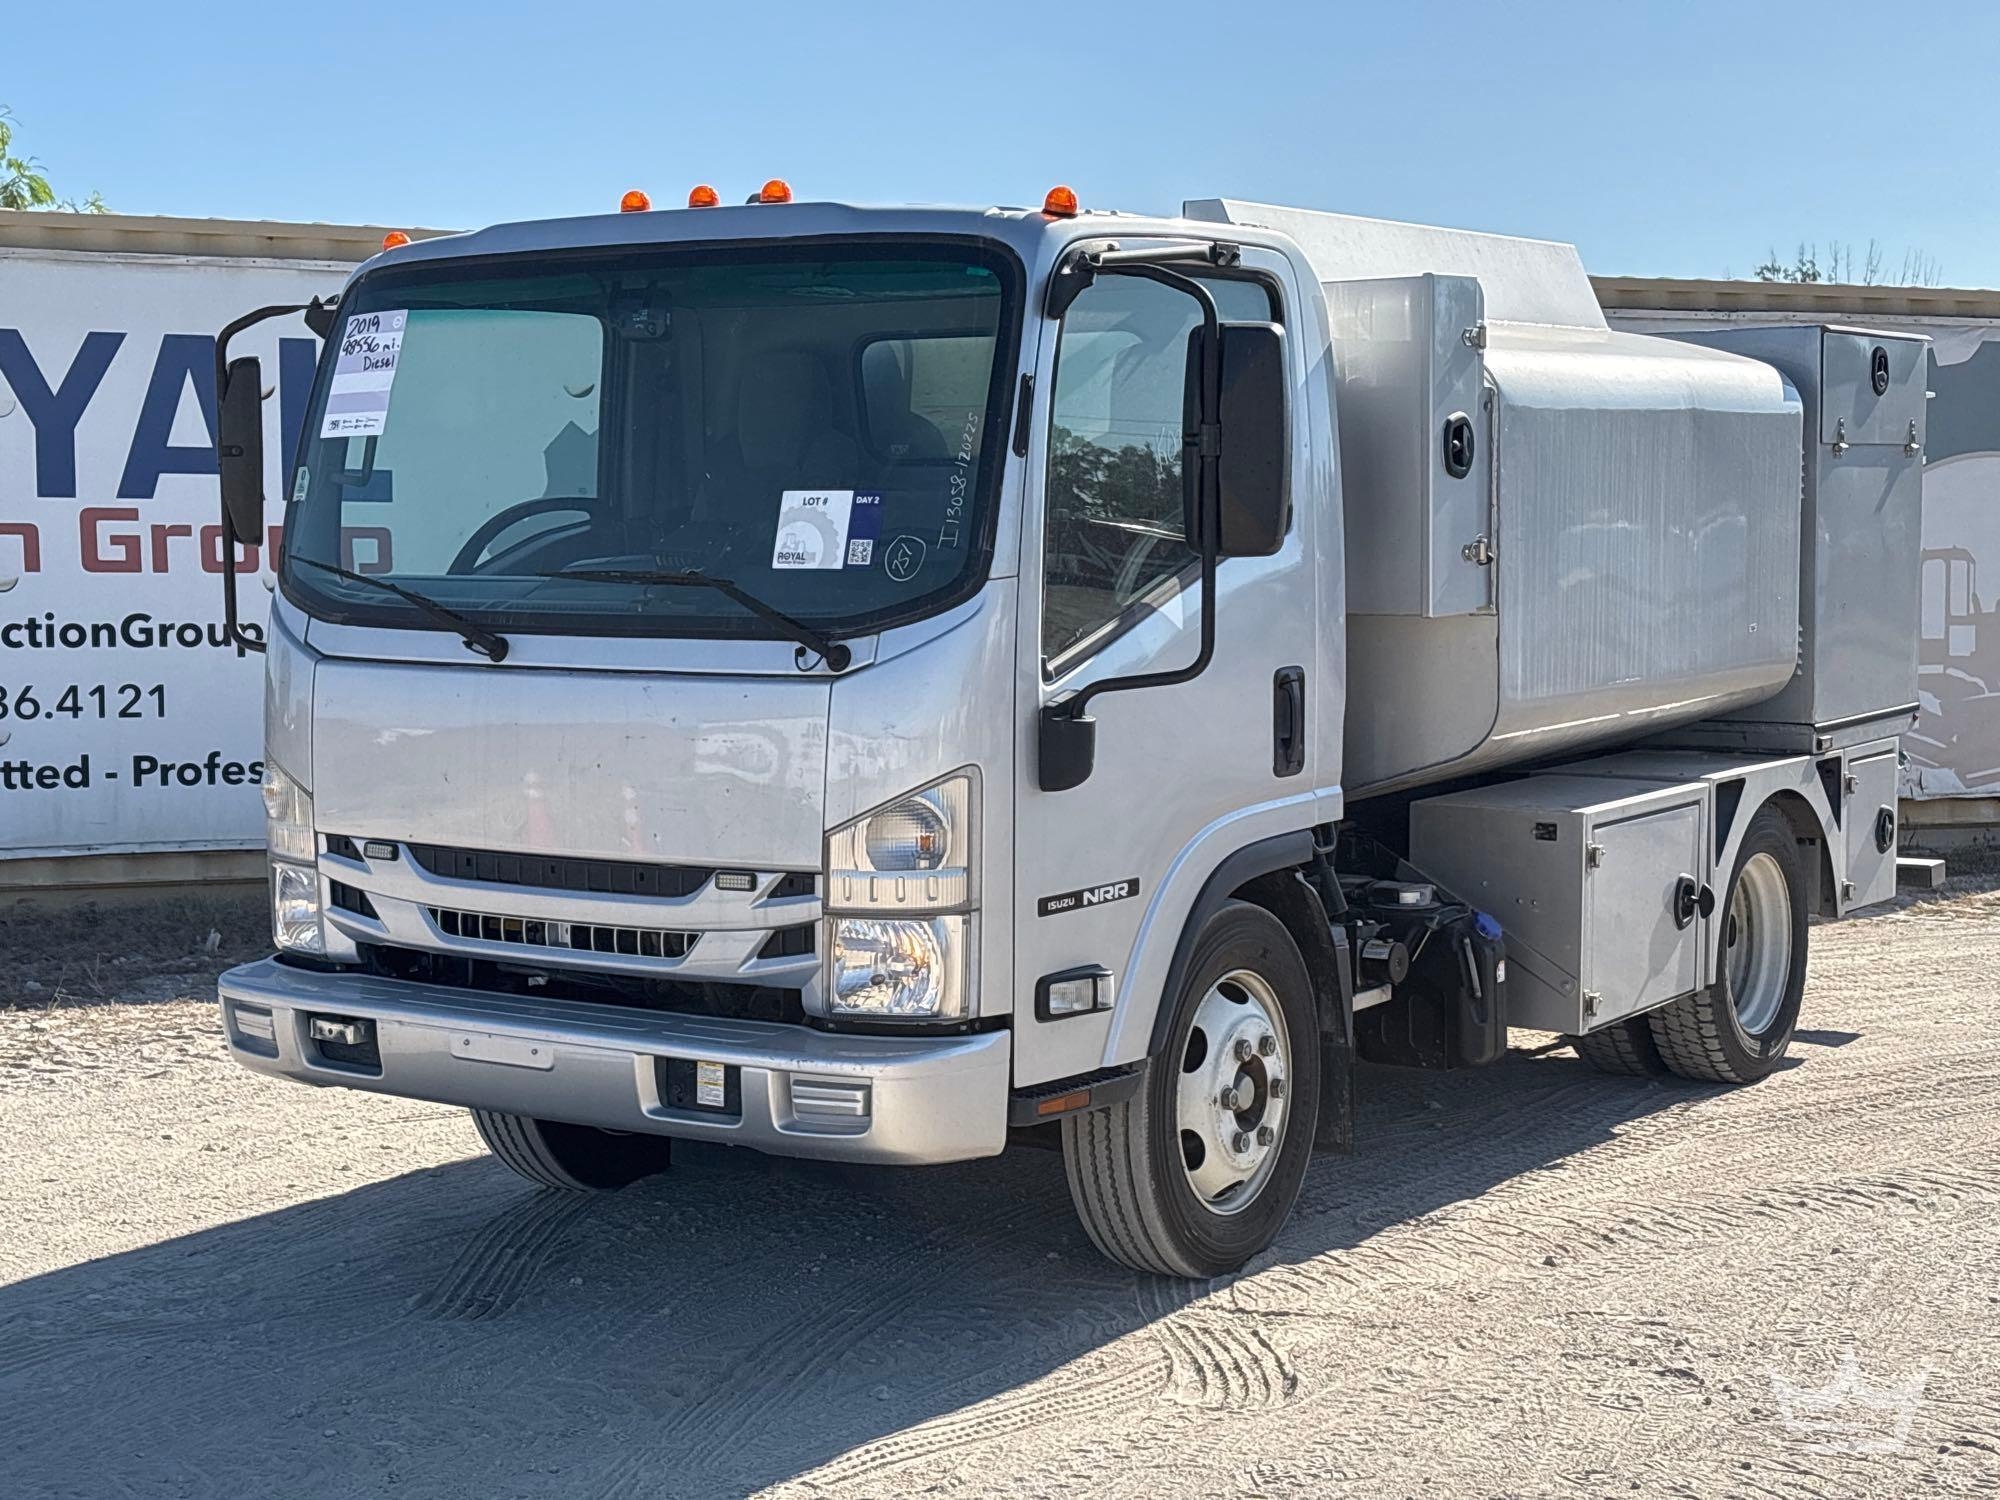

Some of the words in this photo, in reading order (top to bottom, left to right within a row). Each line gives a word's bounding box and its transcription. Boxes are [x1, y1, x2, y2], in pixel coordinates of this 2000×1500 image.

[346, 314, 380, 339] 2019
[342, 335, 379, 356] 98556
[363, 354, 395, 371] Diesel
[803, 497, 821, 506] LOT
[822, 497, 829, 506] #
[856, 496, 873, 504] DAY
[874, 496, 880, 504] 2
[777, 552, 806, 561] ROYAL
[132, 751, 265, 787] Profes
[1047, 897, 1075, 911] ISUZU
[1083, 882, 1129, 905] NRR
